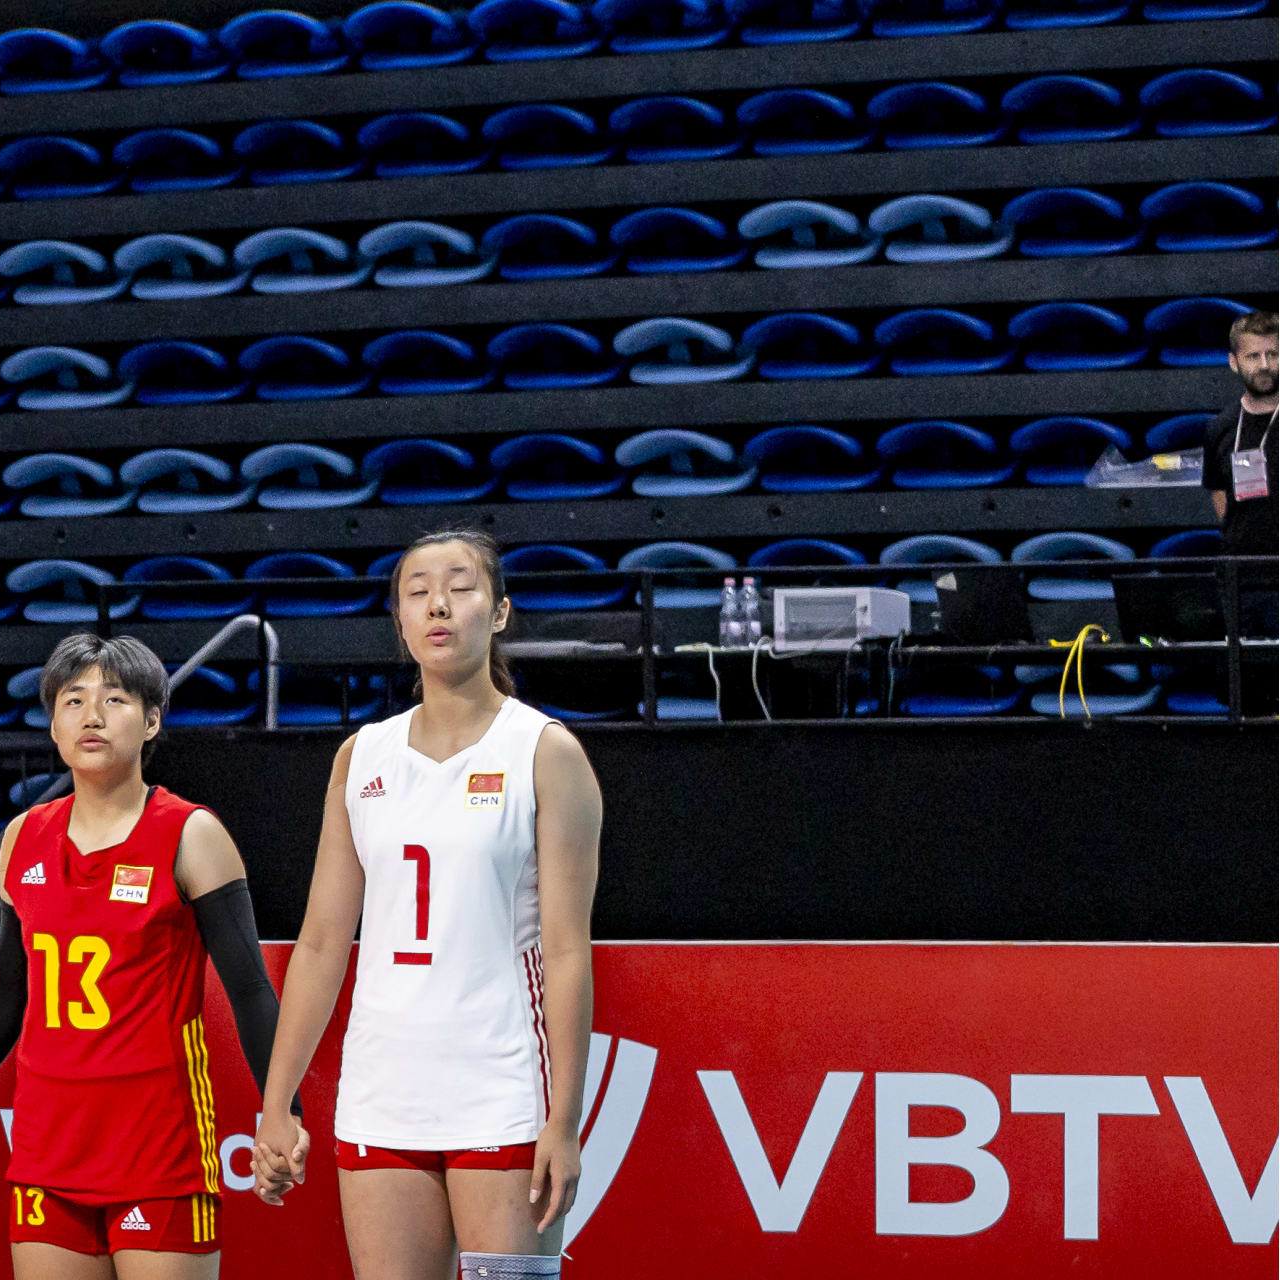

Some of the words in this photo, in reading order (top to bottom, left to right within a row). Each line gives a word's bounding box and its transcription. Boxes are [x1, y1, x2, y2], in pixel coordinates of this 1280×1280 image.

[360, 789, 386, 798] adidas
[470, 796, 499, 806] CHN
[115, 888, 144, 899] CHN
[403, 844, 431, 940] 1
[32, 932, 111, 1030] 13
[696, 1069, 1278, 1245] VBTV
[14, 1186, 46, 1226] 13
[120, 1221, 151, 1231] adidas
